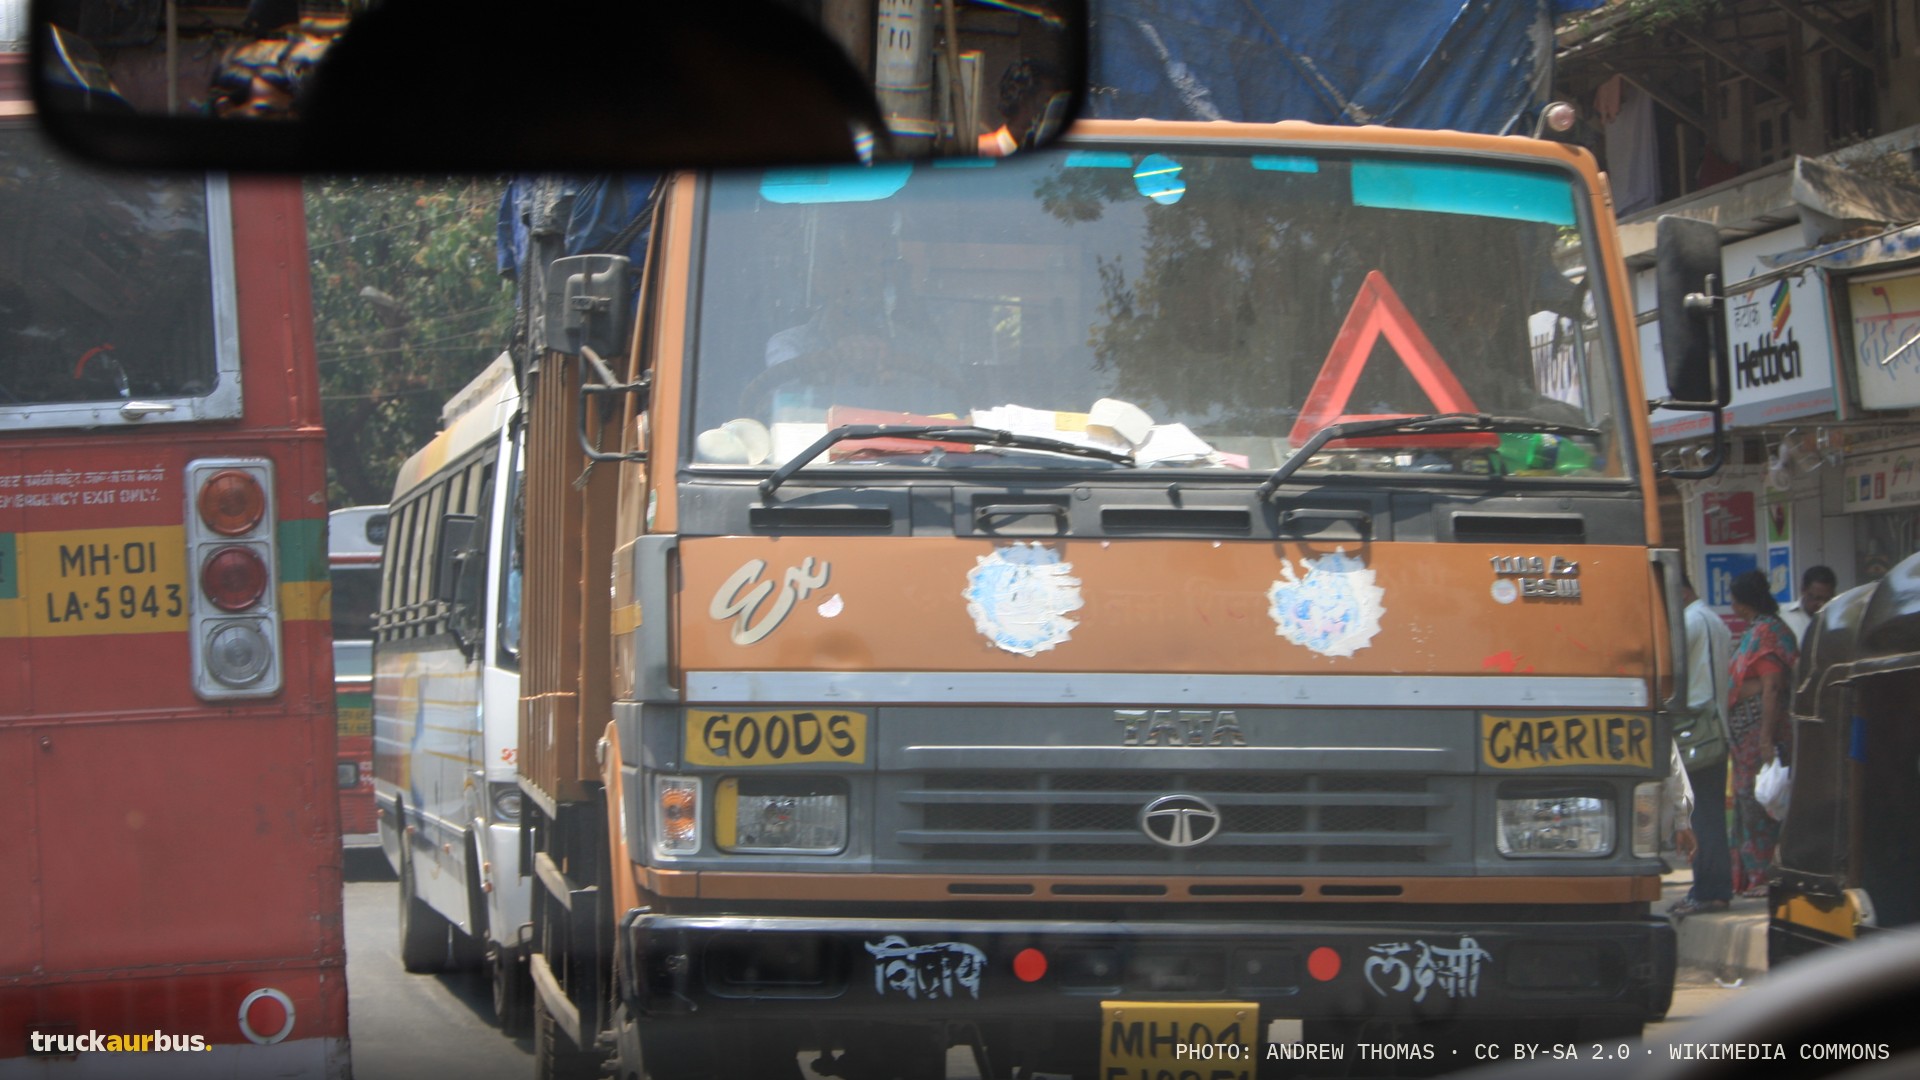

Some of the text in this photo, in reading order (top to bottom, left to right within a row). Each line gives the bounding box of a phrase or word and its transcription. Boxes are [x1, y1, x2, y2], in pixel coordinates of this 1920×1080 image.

[1734, 327, 1802, 391] Hettich
[83, 489, 116, 504] EXIT
[709, 557, 830, 646] Ex
[702, 711, 857, 758] GOODS
[1114, 709, 1247, 747] TATA
[1489, 717, 1648, 763] CARRIER
